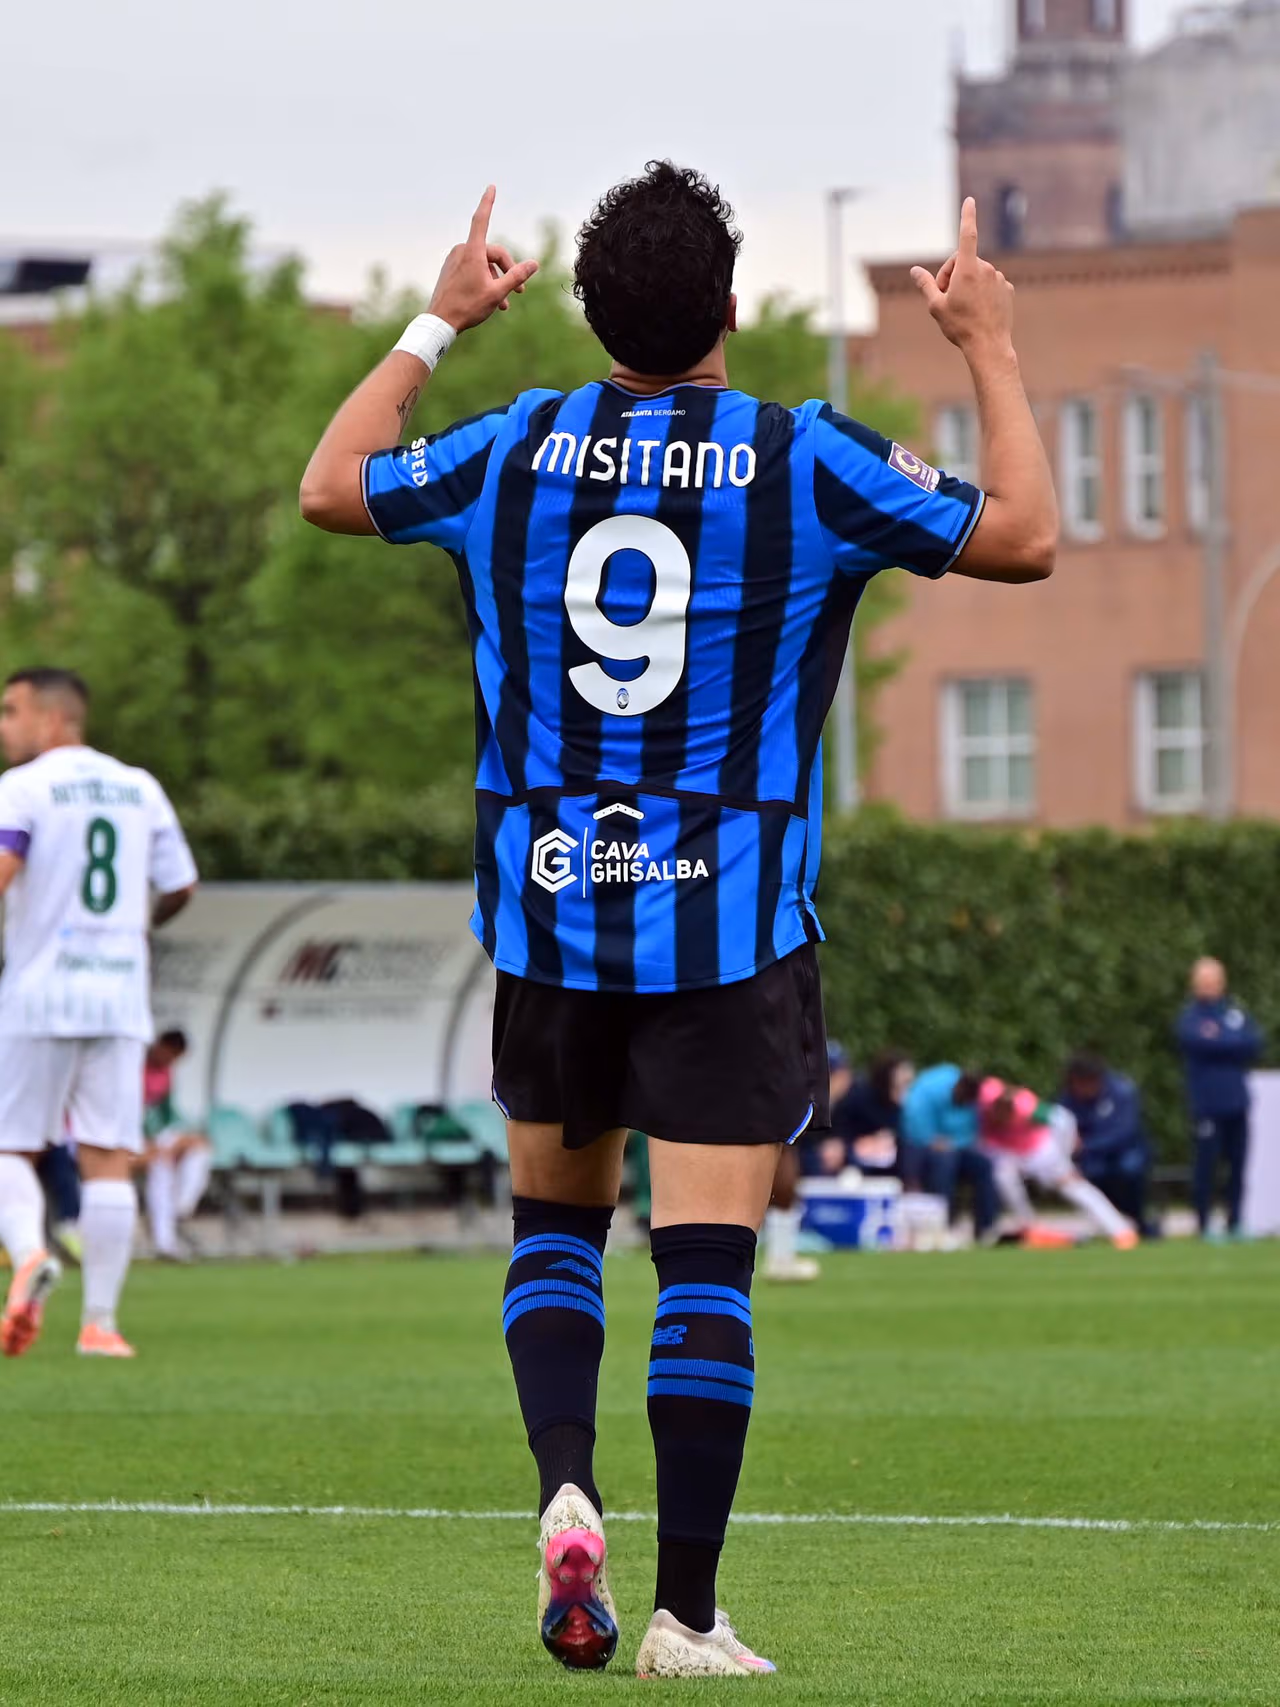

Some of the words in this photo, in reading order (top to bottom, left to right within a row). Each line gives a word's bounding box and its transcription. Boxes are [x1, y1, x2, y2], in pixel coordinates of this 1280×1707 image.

[411, 436, 429, 487] SPED
[531, 431, 757, 489] MISITANO
[564, 514, 691, 716] 9
[82, 817, 117, 915] 8
[590, 840, 650, 860] CAVA
[590, 859, 709, 883] GHISALBA
